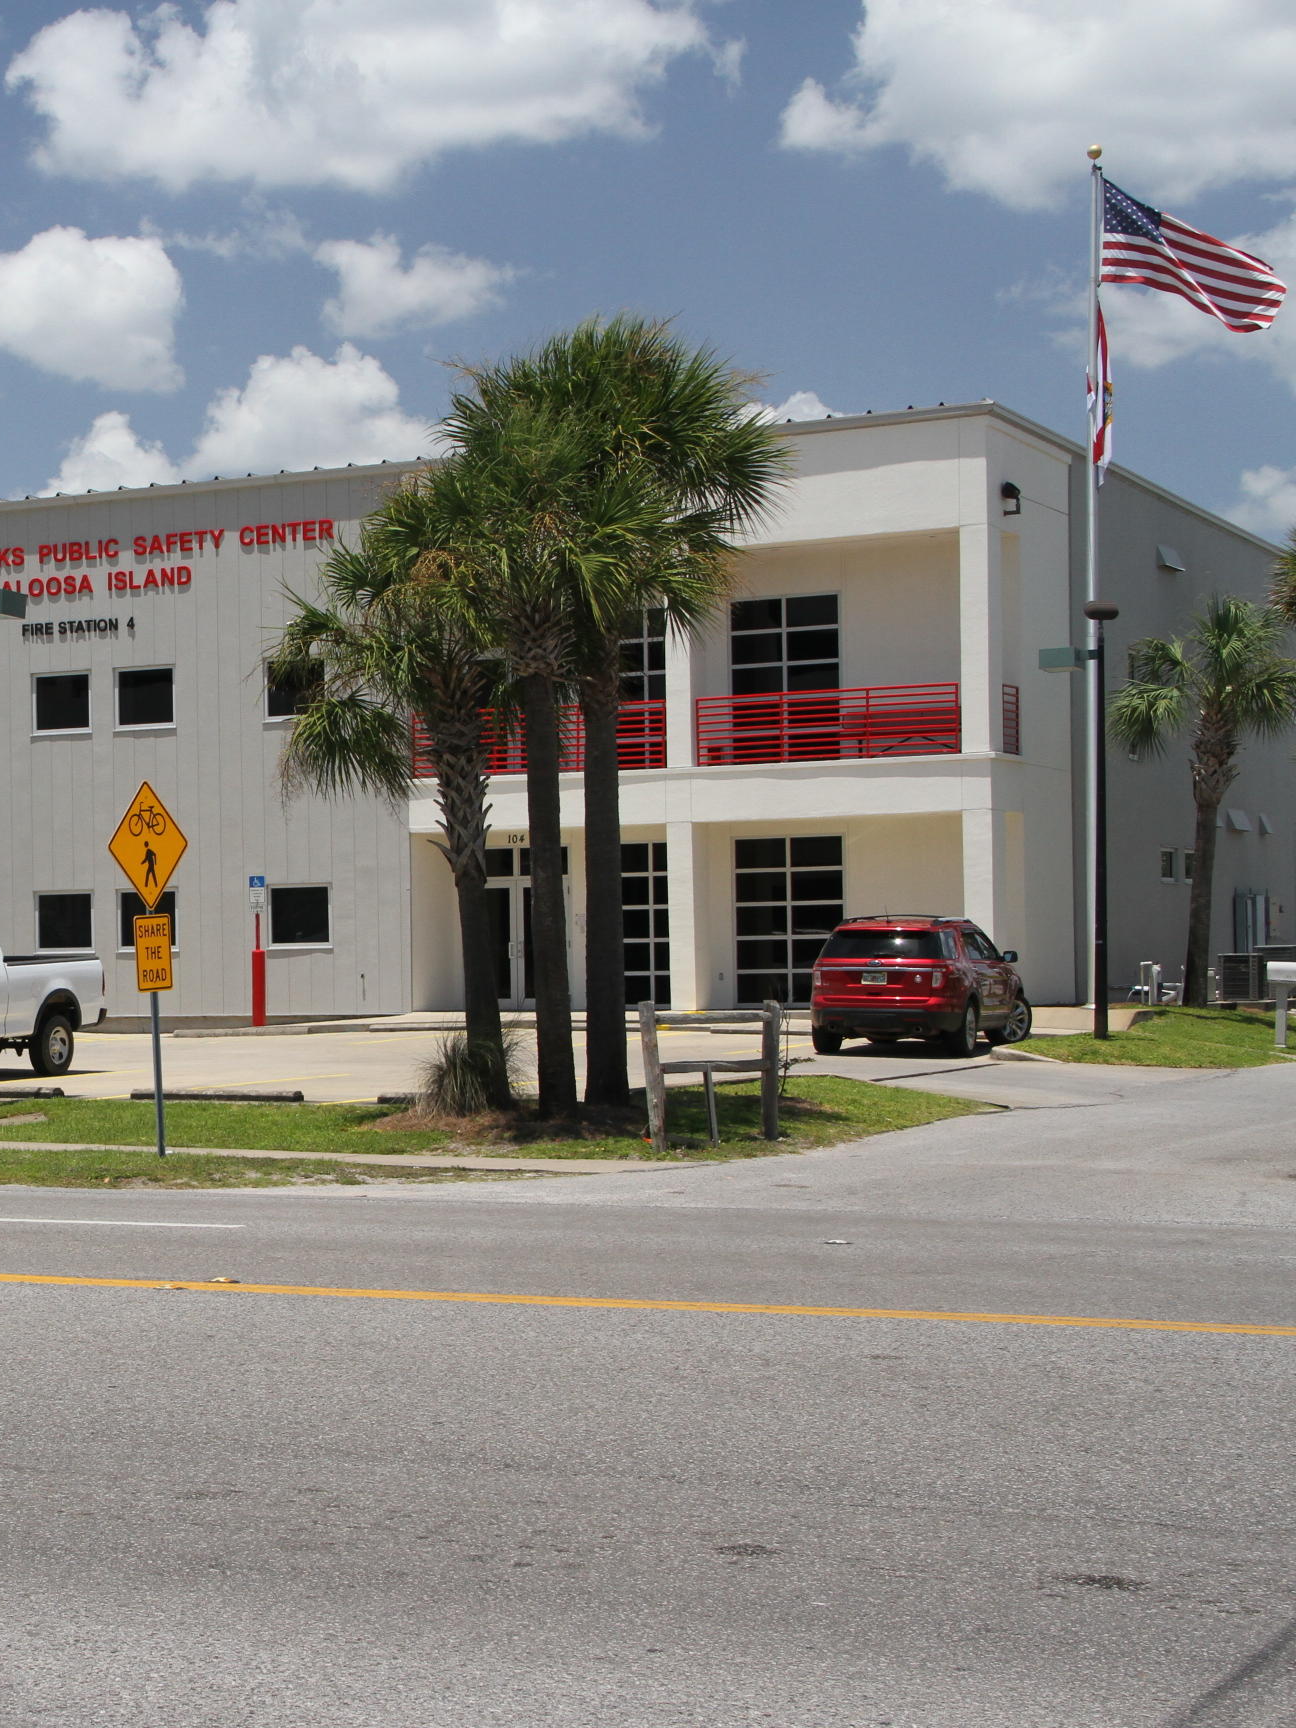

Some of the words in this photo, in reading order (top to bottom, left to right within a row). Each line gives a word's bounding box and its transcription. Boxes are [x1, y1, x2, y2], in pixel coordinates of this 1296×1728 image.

[38, 538, 120, 565] PUBLIC
[133, 528, 225, 557] SAFETY
[239, 518, 336, 547] CENTER
[107, 565, 192, 592] ISLAND
[21, 622, 54, 637] FIRE
[58, 617, 119, 636] STATION
[126, 616, 135, 630] 4
[507, 834, 525, 844] 104
[138, 923, 167, 938] SHARE
[145, 945, 163, 960] THE
[142, 967, 167, 983] ROAD
